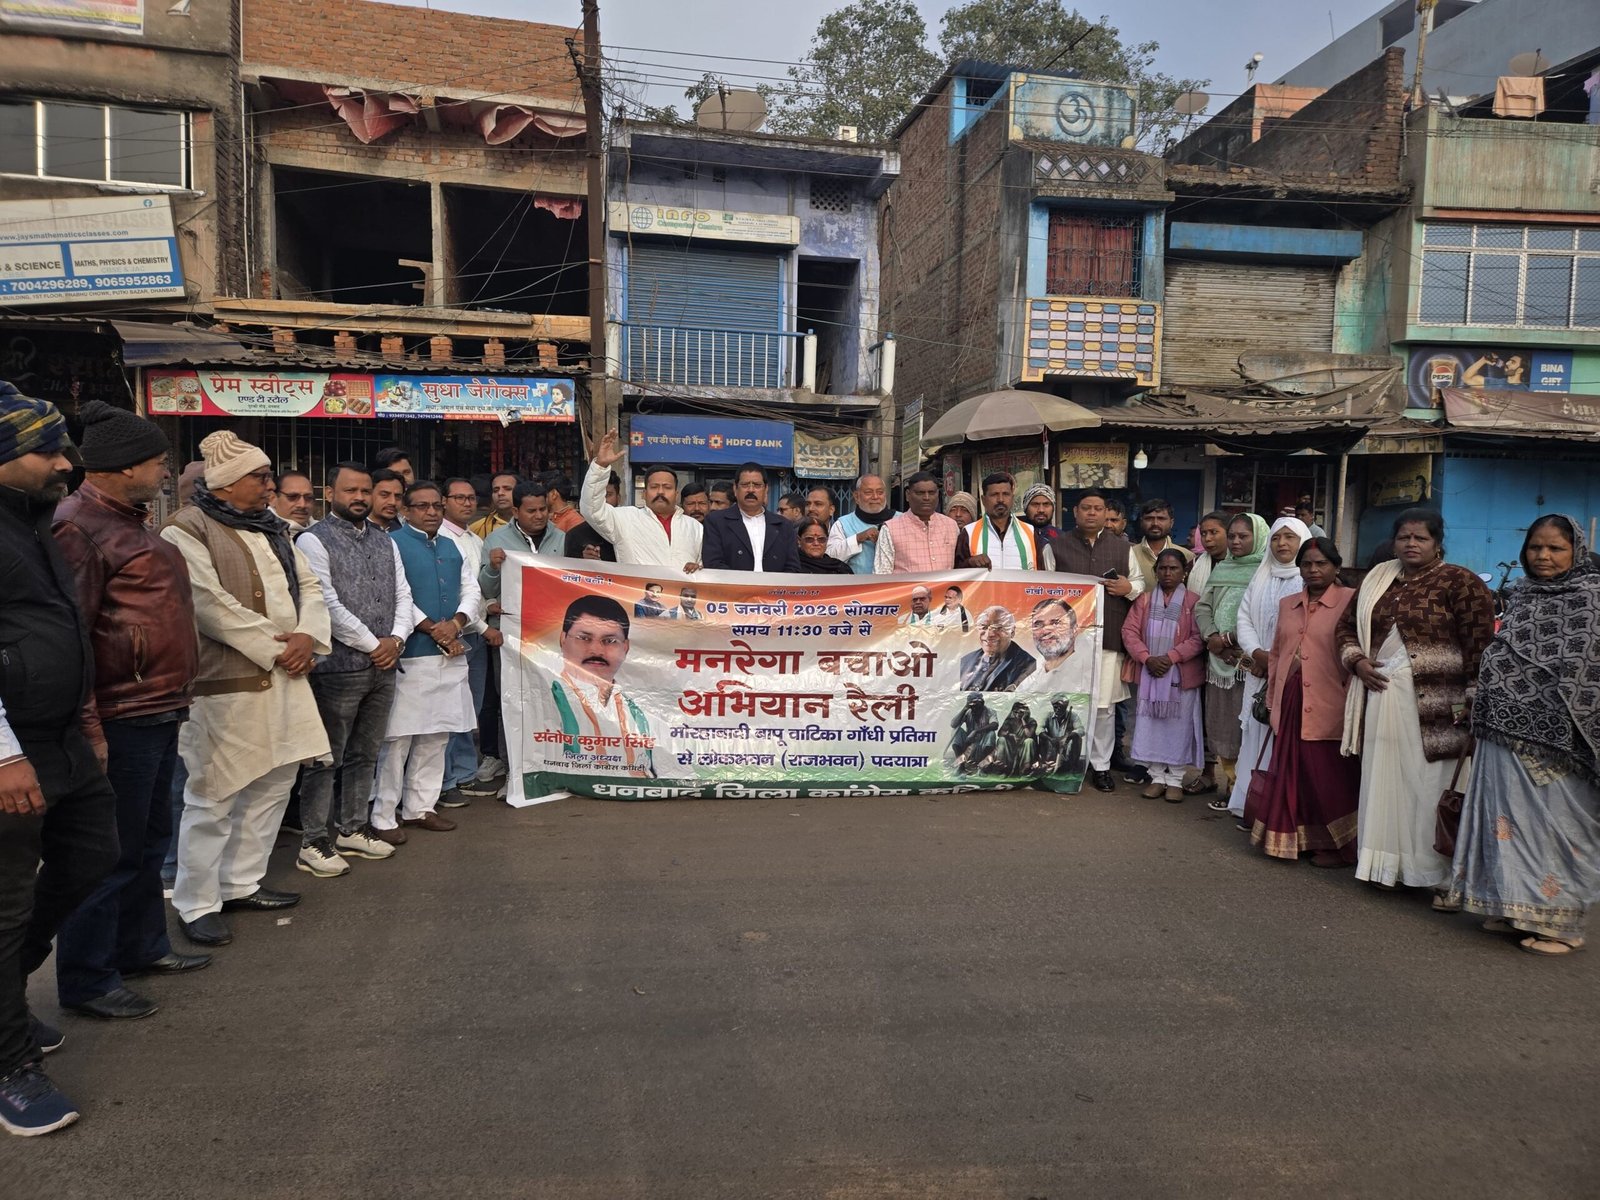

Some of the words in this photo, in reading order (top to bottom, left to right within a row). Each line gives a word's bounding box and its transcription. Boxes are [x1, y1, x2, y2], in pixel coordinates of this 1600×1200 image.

[14, 261, 61, 271] SCIENCE
[74, 259, 98, 267] MATHS,
[99, 258, 126, 266] PHYSICS
[133, 256, 168, 265] CHEMISTRY
[10, 278, 93, 292] 7004296289,
[95, 275, 171, 287] 9065952863
[1540, 363, 1564, 373] BINA
[209, 372, 242, 394] प्रेम
[247, 373, 316, 400] स्वीट्स
[1541, 377, 1563, 387] GIFT
[421, 382, 461, 404] सुधा
[466, 378, 530, 401] जेरोक्स
[256, 395, 265, 404] टी
[267, 395, 289, 404] स्टोल
[726, 438, 752, 447] HDFC
[755, 438, 782, 448] BANK
[798, 443, 856, 457] XEROX
[826, 458, 856, 468] FAX
[706, 602, 728, 614] 05
[735, 600, 787, 616] जनवरी
[794, 604, 838, 616] 2026
[844, 601, 899, 616] सोमवार
[732, 624, 771, 637] समय
[777, 625, 822, 636] 11:30
[828, 620, 853, 636] बजे
[859, 620, 873, 637] से
[674, 640, 804, 675] मनरेगा
[817, 640, 937, 677] बचाओ
[677, 680, 834, 718] अभियान
[843, 682, 919, 722] रैली
[533, 728, 573, 745] संतोष
[578, 735, 622, 752] कुमार
[625, 732, 657, 749] सिंह
[755, 728, 788, 747] बापू
[788, 724, 842, 740] वाटिका
[847, 725, 885, 742] गाँधी
[889, 726, 937, 744] प्रतिमा
[564, 751, 588, 762] जिला
[590, 754, 622, 762] अध्यक्ष
[677, 748, 693, 765] से
[698, 748, 776, 766] लोकभवन
[781, 750, 865, 771] (राजभवन)
[871, 755, 929, 768] पदयात्रा
[713, 783, 800, 799] जिला
